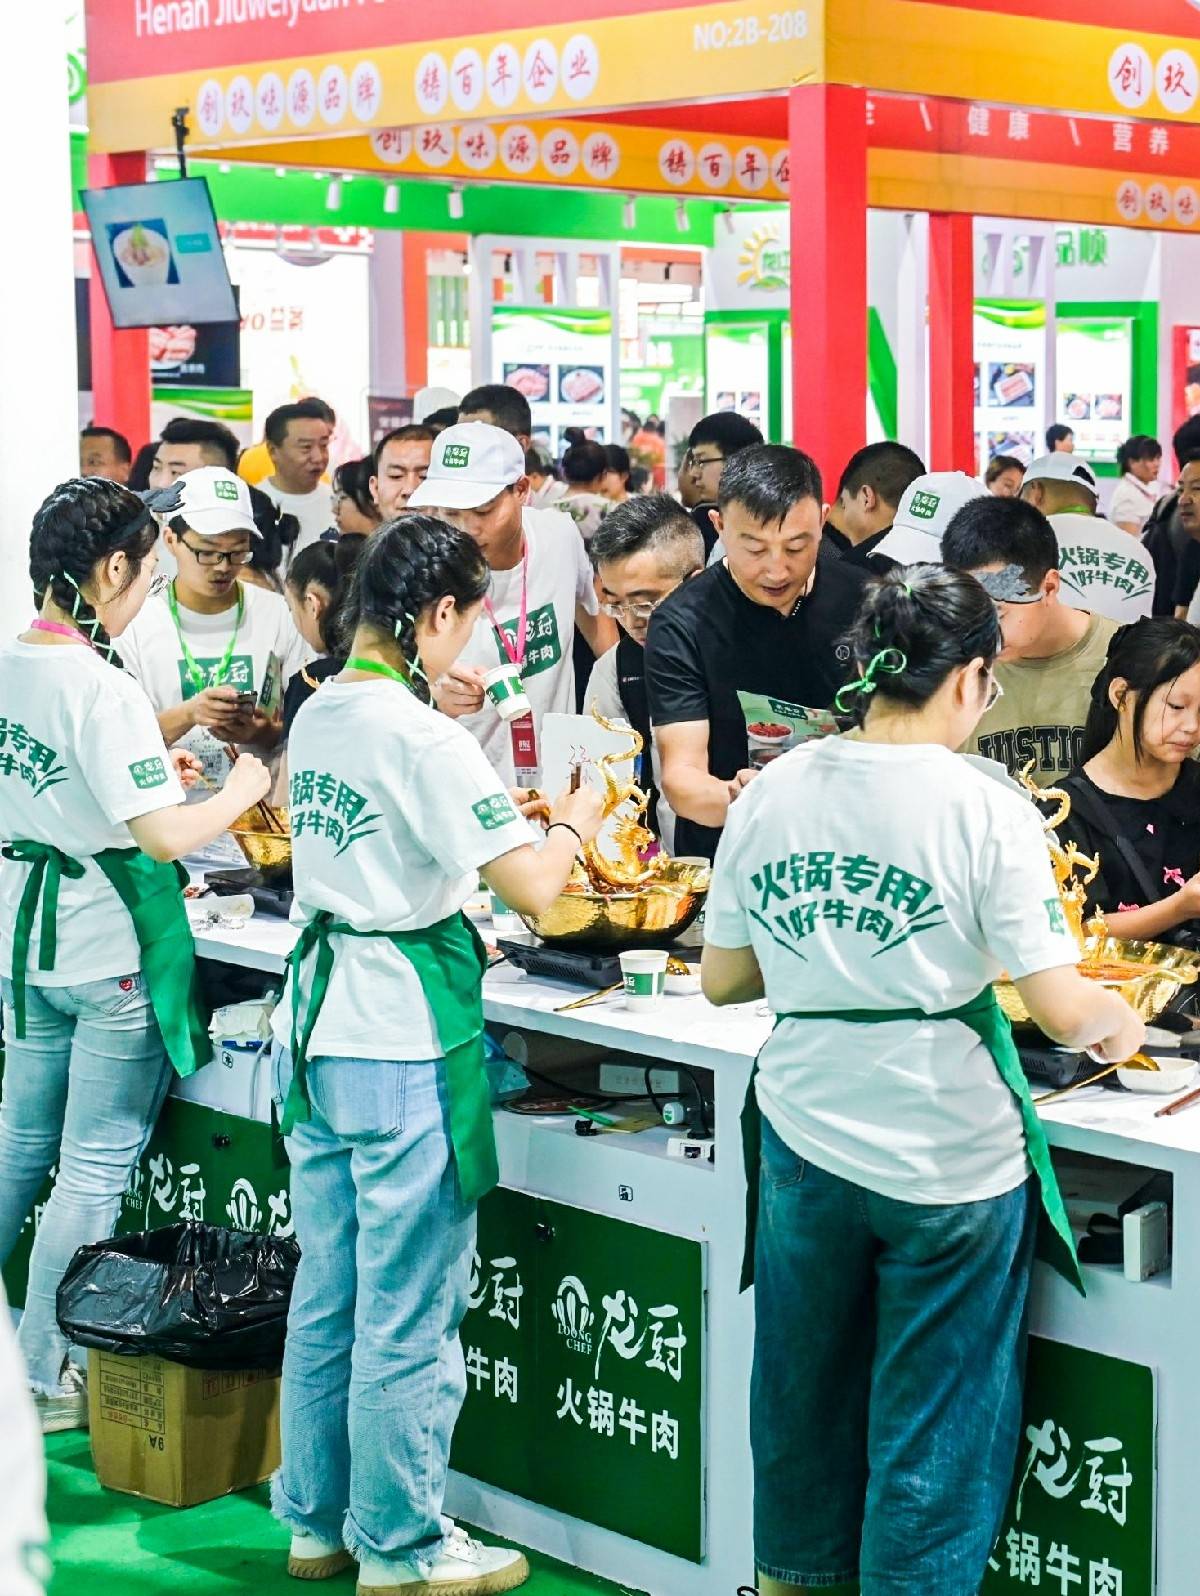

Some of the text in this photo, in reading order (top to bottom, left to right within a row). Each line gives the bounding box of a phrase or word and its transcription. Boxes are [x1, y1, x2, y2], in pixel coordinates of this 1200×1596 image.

[693, 10, 808, 51] NO:2B-208
[967, 106, 1030, 142] 健康
[1111, 122, 1171, 156] 营养
[1060, 547, 1150, 584] 火锅专用
[1077, 570, 1135, 594] 好牛肉
[0, 718, 57, 773] 专用
[750, 851, 933, 914] 火锅专用
[788, 899, 895, 942] 好牛肉
[125, 1196, 143, 1211] CHEF
[557, 1322, 593, 1345] LOONG
[566, 1338, 593, 1356] CHEF
[595, 1289, 688, 1383] 龙厨
[556, 1378, 679, 1460] 火锅牛肉
[1016, 1419, 1133, 1527] 龙厨
